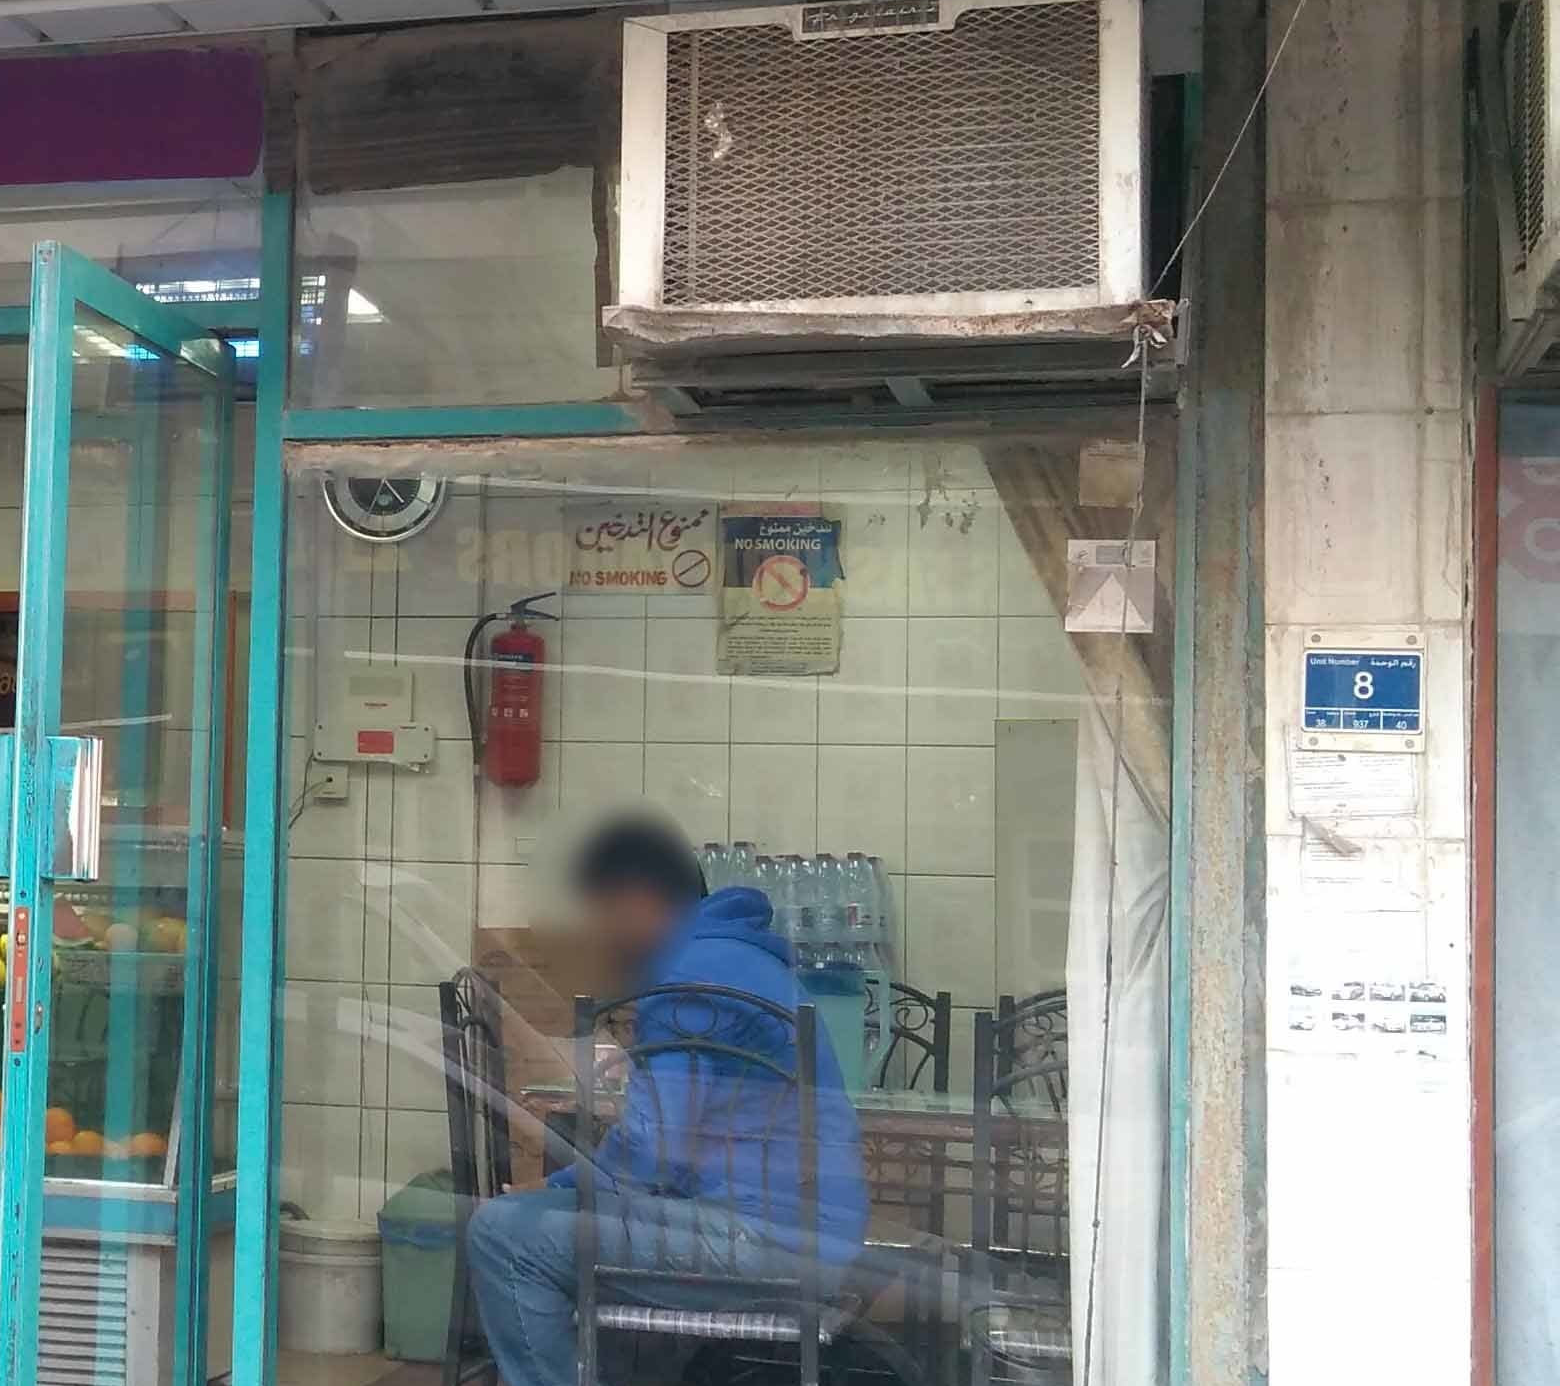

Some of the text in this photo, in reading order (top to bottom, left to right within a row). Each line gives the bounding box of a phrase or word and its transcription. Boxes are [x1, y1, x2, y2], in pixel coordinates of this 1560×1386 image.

[735, 538, 822, 551] NO SMOKING
[569, 570, 669, 587] NO SMOKING
[1353, 671, 1374, 700] 8
